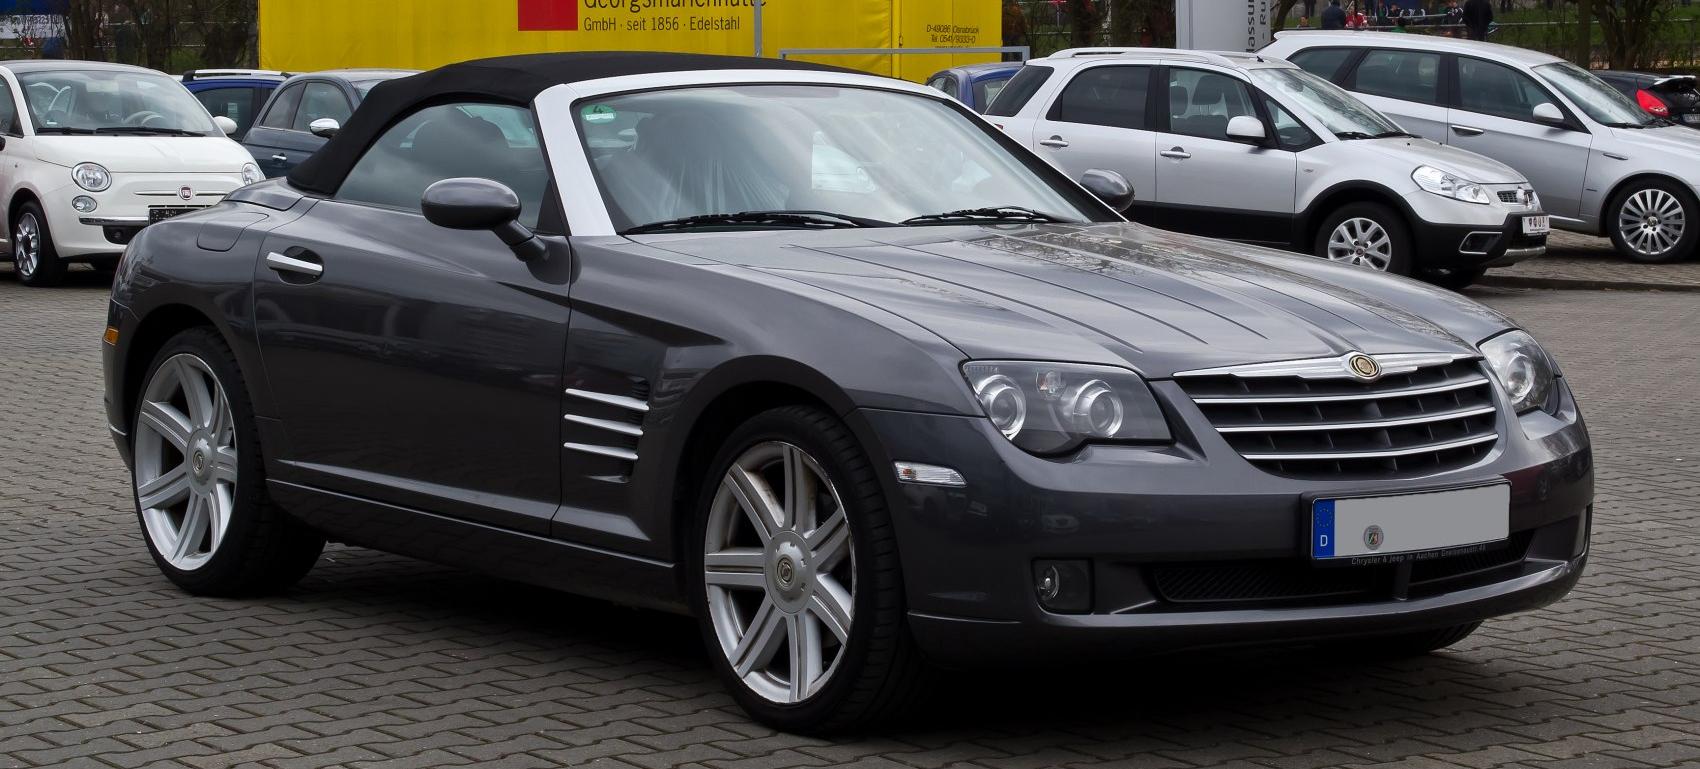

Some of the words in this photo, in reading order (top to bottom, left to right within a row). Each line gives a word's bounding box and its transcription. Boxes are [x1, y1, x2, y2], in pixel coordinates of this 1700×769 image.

[584, 17, 617, 31] GmbH
[626, 17, 646, 31] seit
[651, 17, 679, 31] 1856
[689, 16, 740, 31] Edelstahl
[1320, 534, 1328, 547] D
[1351, 555, 1381, 566] Chrysler
[1389, 555, 1405, 563] Jeep
[1416, 550, 1439, 560] Aachen
